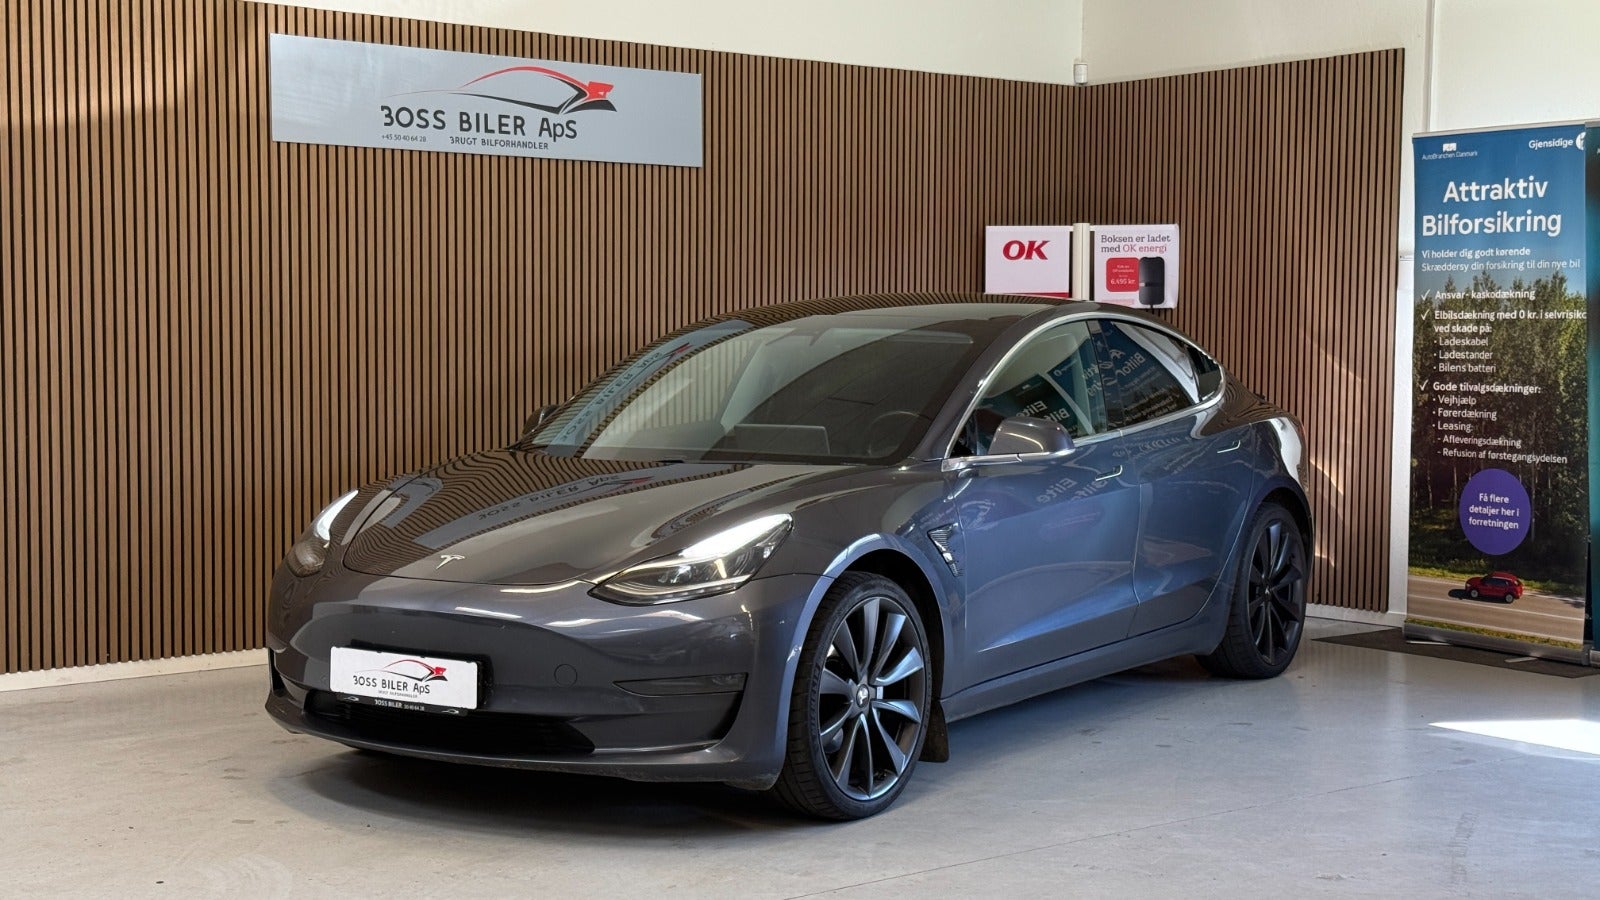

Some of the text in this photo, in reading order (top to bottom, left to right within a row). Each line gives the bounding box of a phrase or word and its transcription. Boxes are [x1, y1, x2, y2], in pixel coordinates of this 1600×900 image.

[459, 111, 526, 136] BILER
[538, 116, 578, 142] ApS
[481, 138, 549, 150] BILFORHANDLER
[1528, 138, 1574, 150] Gjensidige
[1443, 176, 1548, 203] Attraktiv
[1422, 209, 1562, 236] Bilforsikring
[1101, 234, 1134, 243] Boksen
[1147, 234, 1171, 243] ladet
[1002, 240, 1050, 260] OK
[1101, 244, 1167, 254] med OK energi
[1422, 247, 1530, 259] Vi holder dig godt kørende
[1422, 259, 1580, 272] Skræddersy din forsikring til din nye bil
[1471, 290, 1536, 300] kaskodækning
[1434, 310, 1496, 322] Elbilsdækning
[1497, 310, 1516, 320] med
[1518, 311, 1525, 320] 0
[1527, 310, 1539, 320] kr.
[1540, 310, 1543, 319] i
[1434, 324, 1492, 334] ved skade på:
[1439, 337, 1488, 346] Ladeskabel
[1438, 350, 1493, 360] Ladestander
[1438, 363, 1496, 373] Bilens batteri
[1432, 382, 1542, 395] Gode tilvalgsdækninger:
[1438, 395, 1476, 406] Vejhjælp
[1438, 408, 1498, 420] Førerdækning
[1443, 435, 1522, 448] Afleveringsdækning
[1442, 448, 1568, 464] Refusion af førstegangsydelsen
[1479, 493, 1510, 504] Få flere
[1468, 505, 1520, 516] detaljer her i
[1468, 517, 1519, 530] forretningen
[382, 679, 408, 691] BILER
[413, 682, 430, 694] ApS
